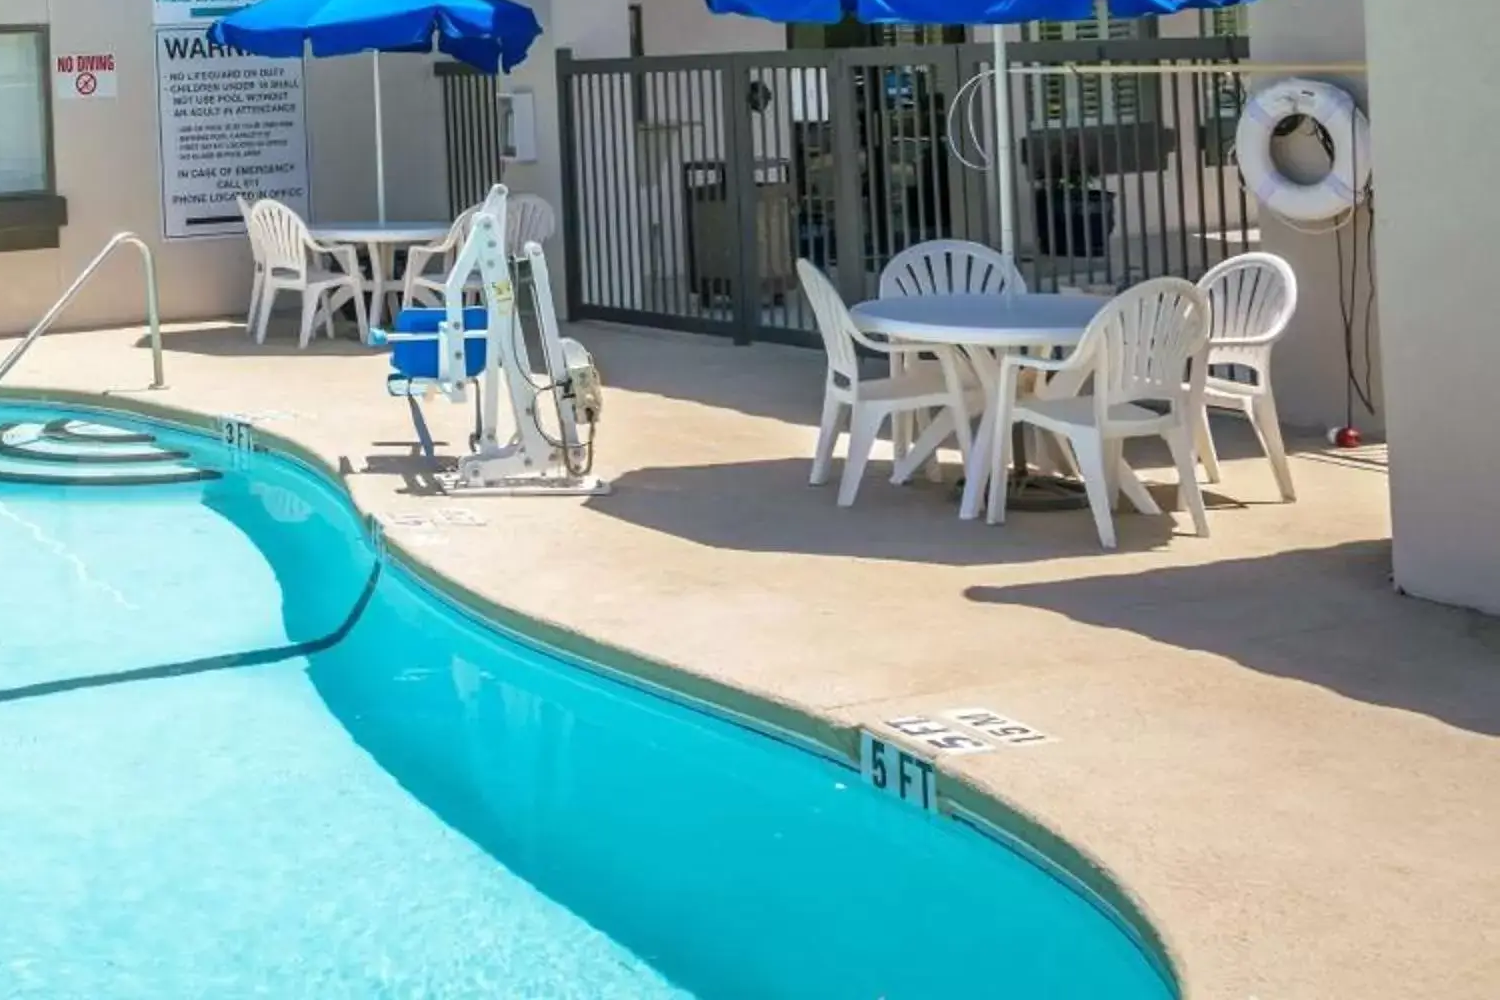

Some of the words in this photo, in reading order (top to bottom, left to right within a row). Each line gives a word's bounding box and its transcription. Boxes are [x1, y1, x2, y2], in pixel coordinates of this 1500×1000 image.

[57, 56, 73, 73] NO
[77, 53, 115, 72] DIVING
[216, 180, 242, 190] CALL
[226, 422, 234, 444] 3
[872, 739, 886, 789] 5
[900, 753, 933, 810] FT
